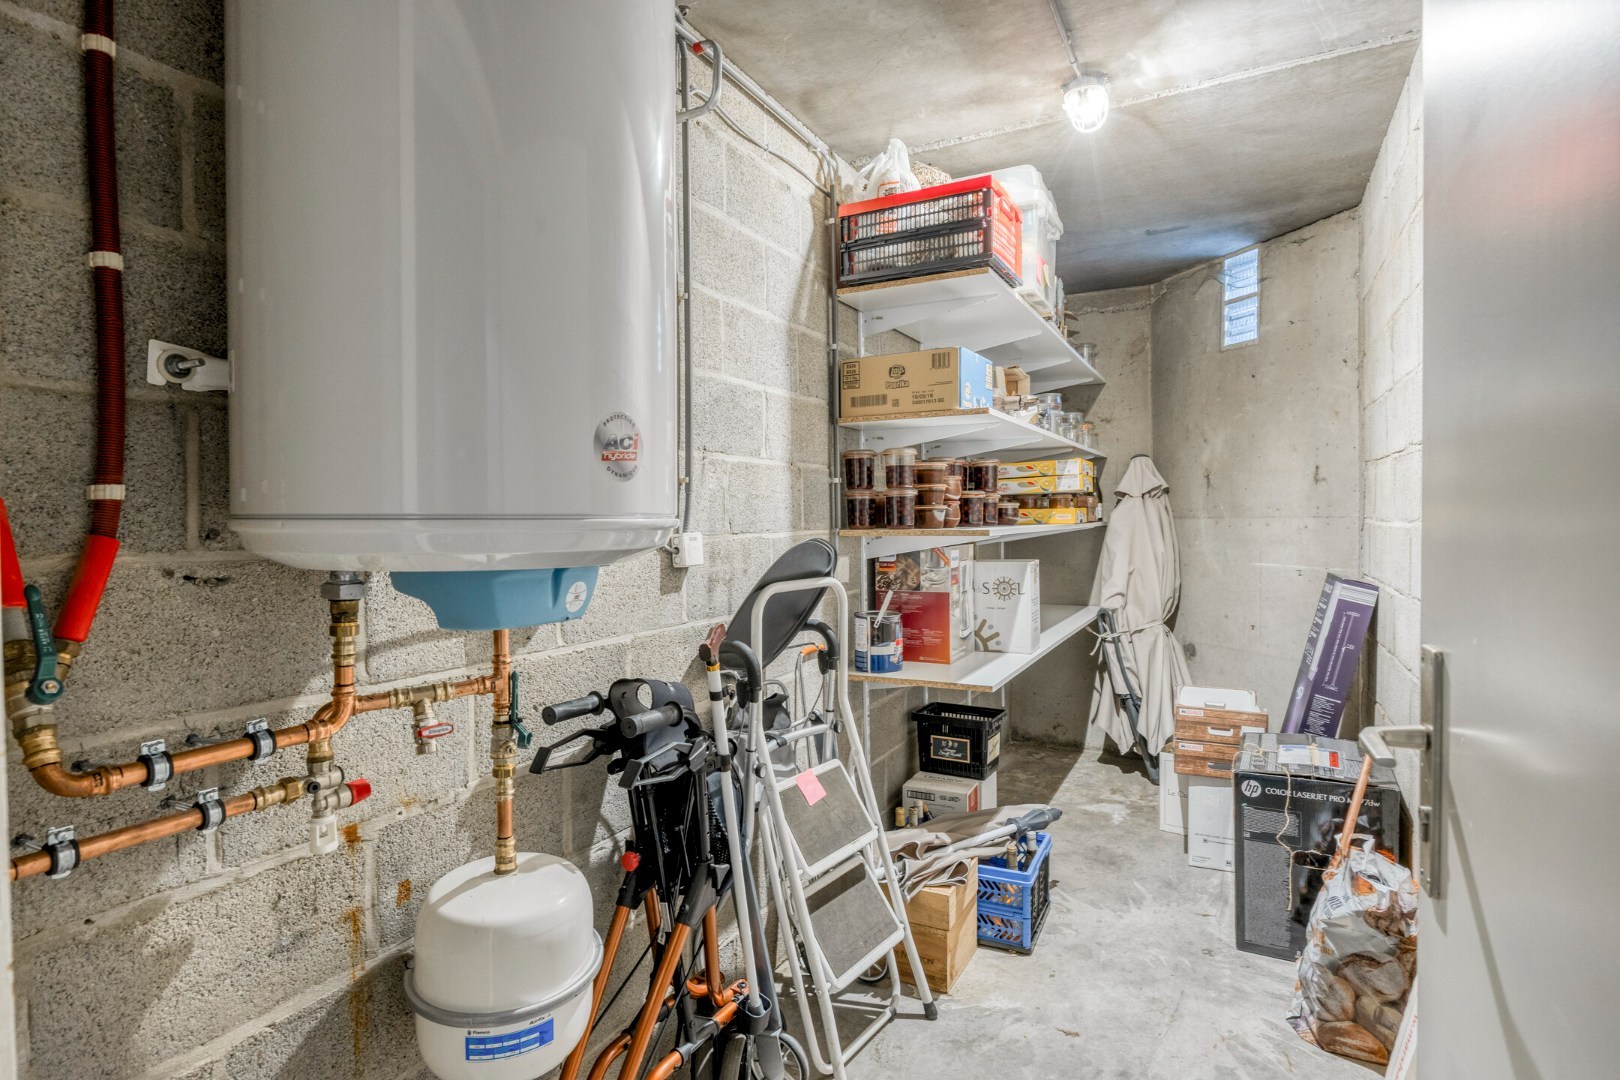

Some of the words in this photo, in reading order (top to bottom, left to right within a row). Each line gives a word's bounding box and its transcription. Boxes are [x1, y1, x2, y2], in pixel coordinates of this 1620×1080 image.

[602, 414, 636, 427] PROTECTION
[603, 451, 636, 461] hybride
[606, 465, 638, 478] DYNAMIQUE
[1243, 779, 1260, 797] hp
[1293, 790, 1328, 801] LASERJET
[1329, 794, 1345, 803] PRO
